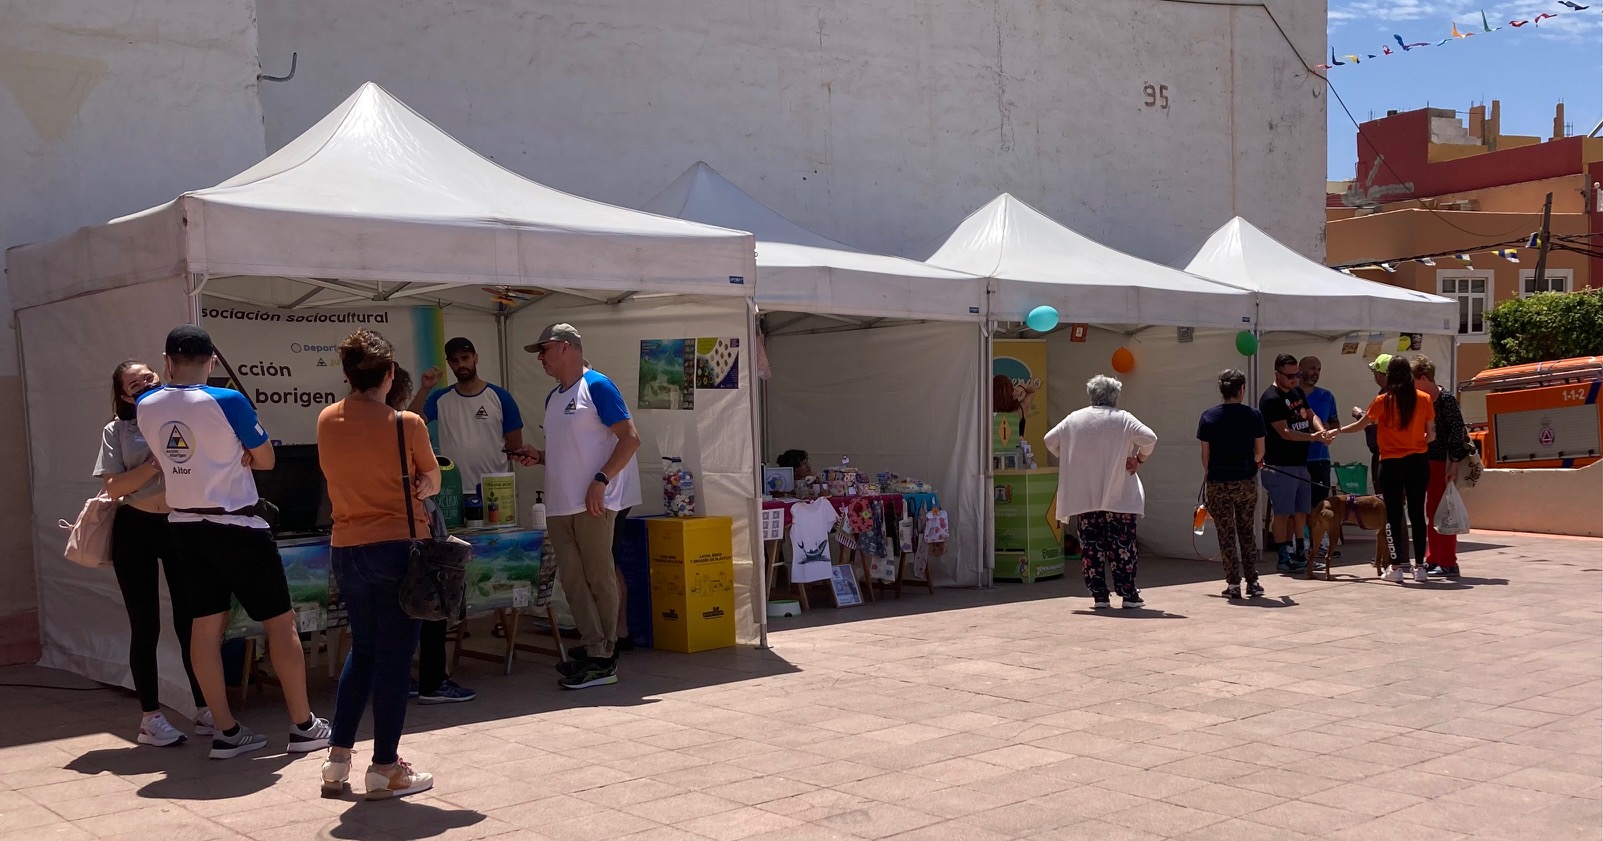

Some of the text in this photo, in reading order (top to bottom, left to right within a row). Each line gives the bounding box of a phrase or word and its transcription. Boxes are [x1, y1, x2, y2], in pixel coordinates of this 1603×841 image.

[1143, 84, 1169, 109] 95
[202, 308, 389, 323] sociación sociocultural
[304, 344, 337, 353] Deport
[238, 361, 292, 377] cción
[256, 388, 336, 408] borigen
[1562, 388, 1585, 401] 1-1-2
[172, 466, 192, 475] Aitor
[1385, 522, 1397, 560] adidas
